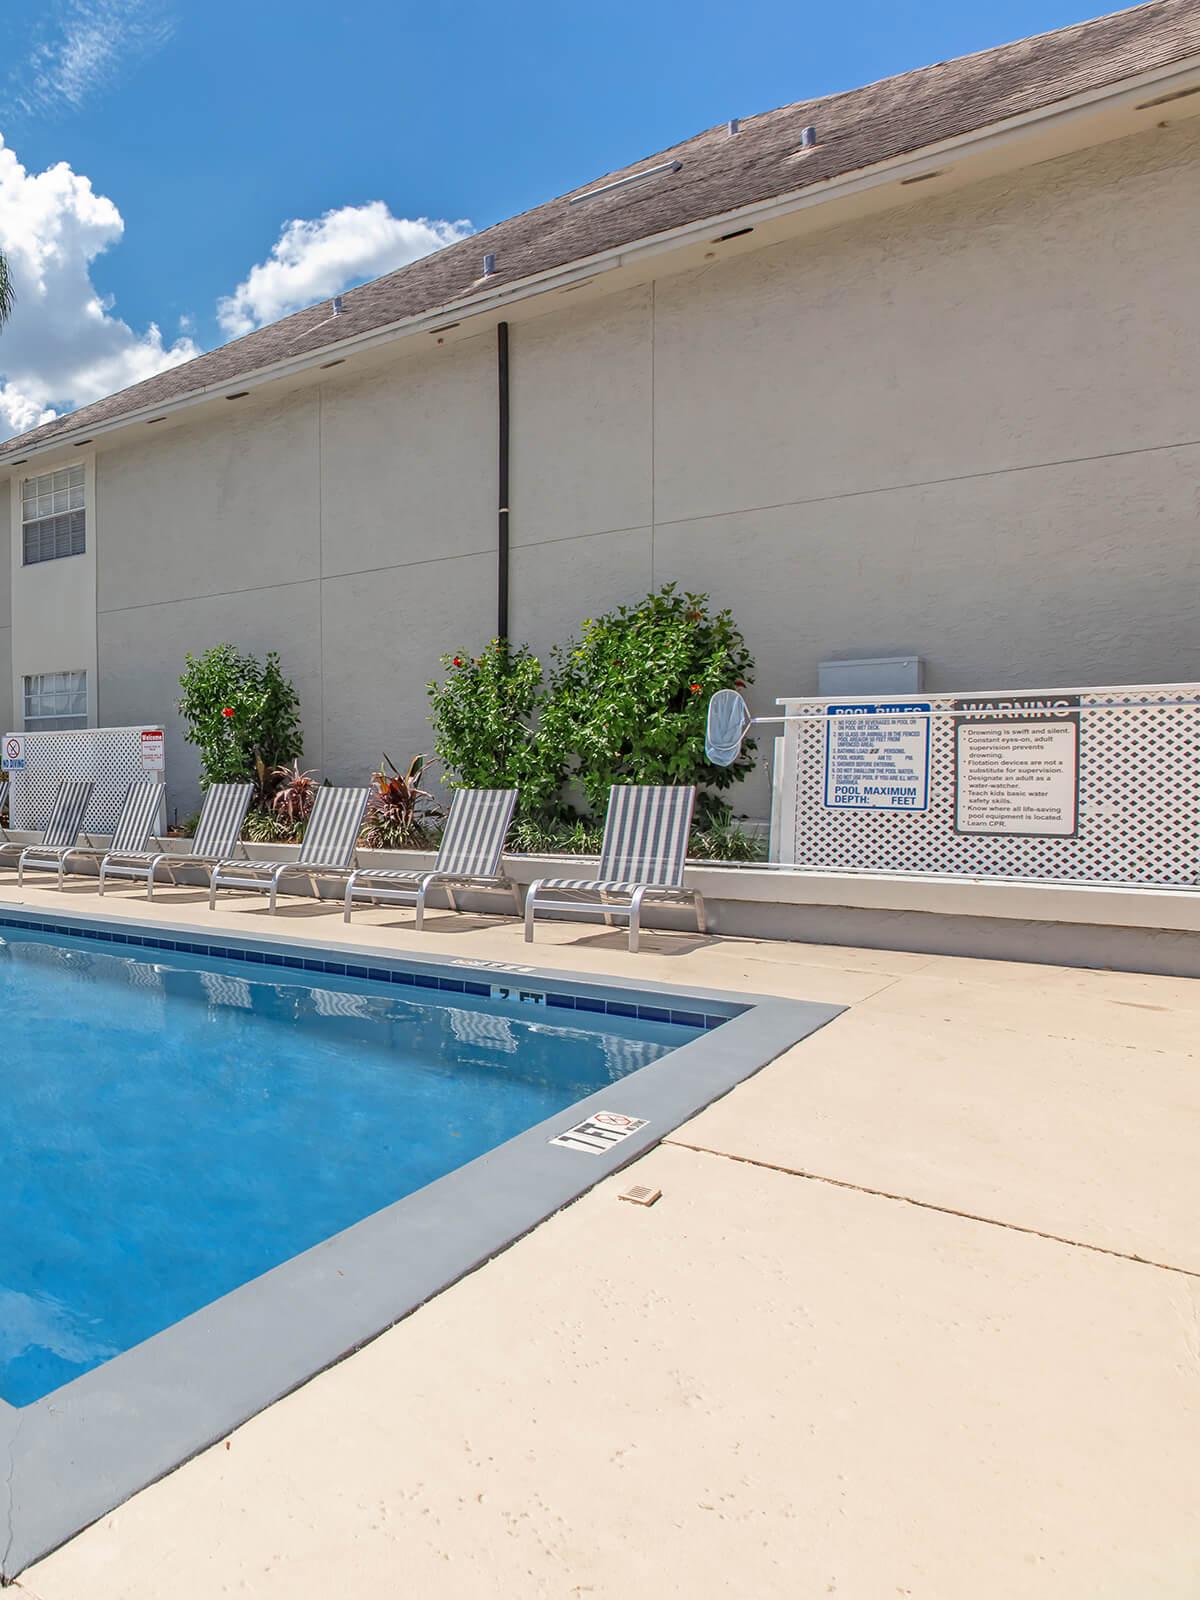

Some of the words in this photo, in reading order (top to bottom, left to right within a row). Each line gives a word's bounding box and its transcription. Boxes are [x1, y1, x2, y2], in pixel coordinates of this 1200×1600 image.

[962, 700, 1070, 720] WARNING
[3, 760, 9, 768] NO
[10, 760, 24, 768] DIVING
[835, 786, 860, 794] POOL
[864, 787, 916, 795] MAXIMUM
[835, 795, 869, 803] DEPTH:
